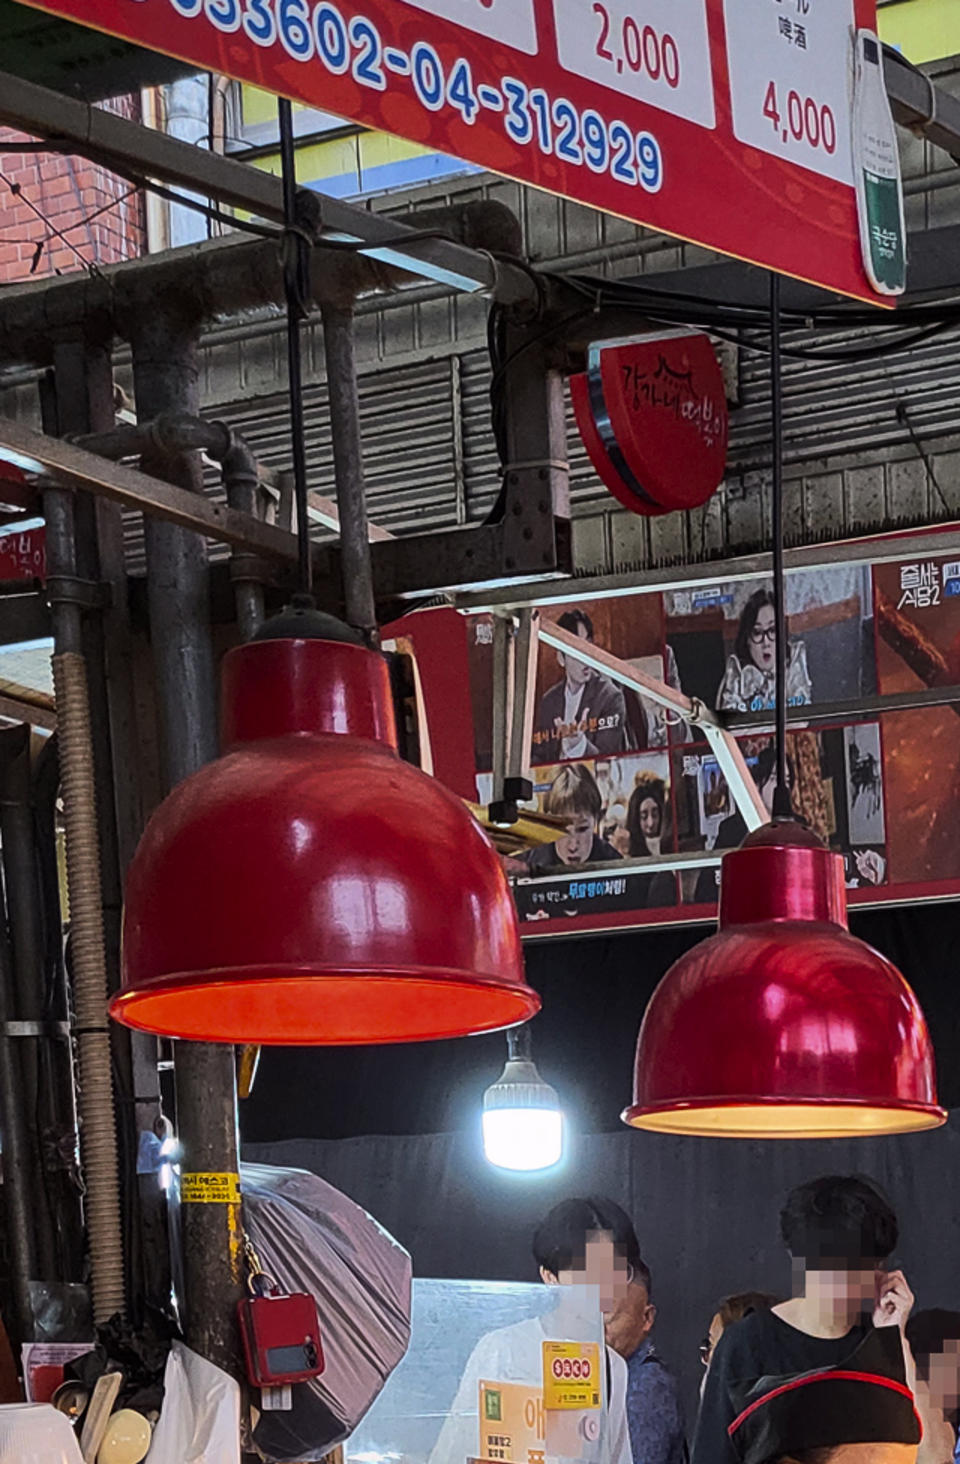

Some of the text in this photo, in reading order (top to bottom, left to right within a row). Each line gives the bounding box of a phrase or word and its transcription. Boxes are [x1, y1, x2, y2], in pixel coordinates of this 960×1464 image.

[593, 3, 680, 88] 2,000
[174, 0, 661, 191] 53602-04-312929
[763, 81, 836, 154] 4,000
